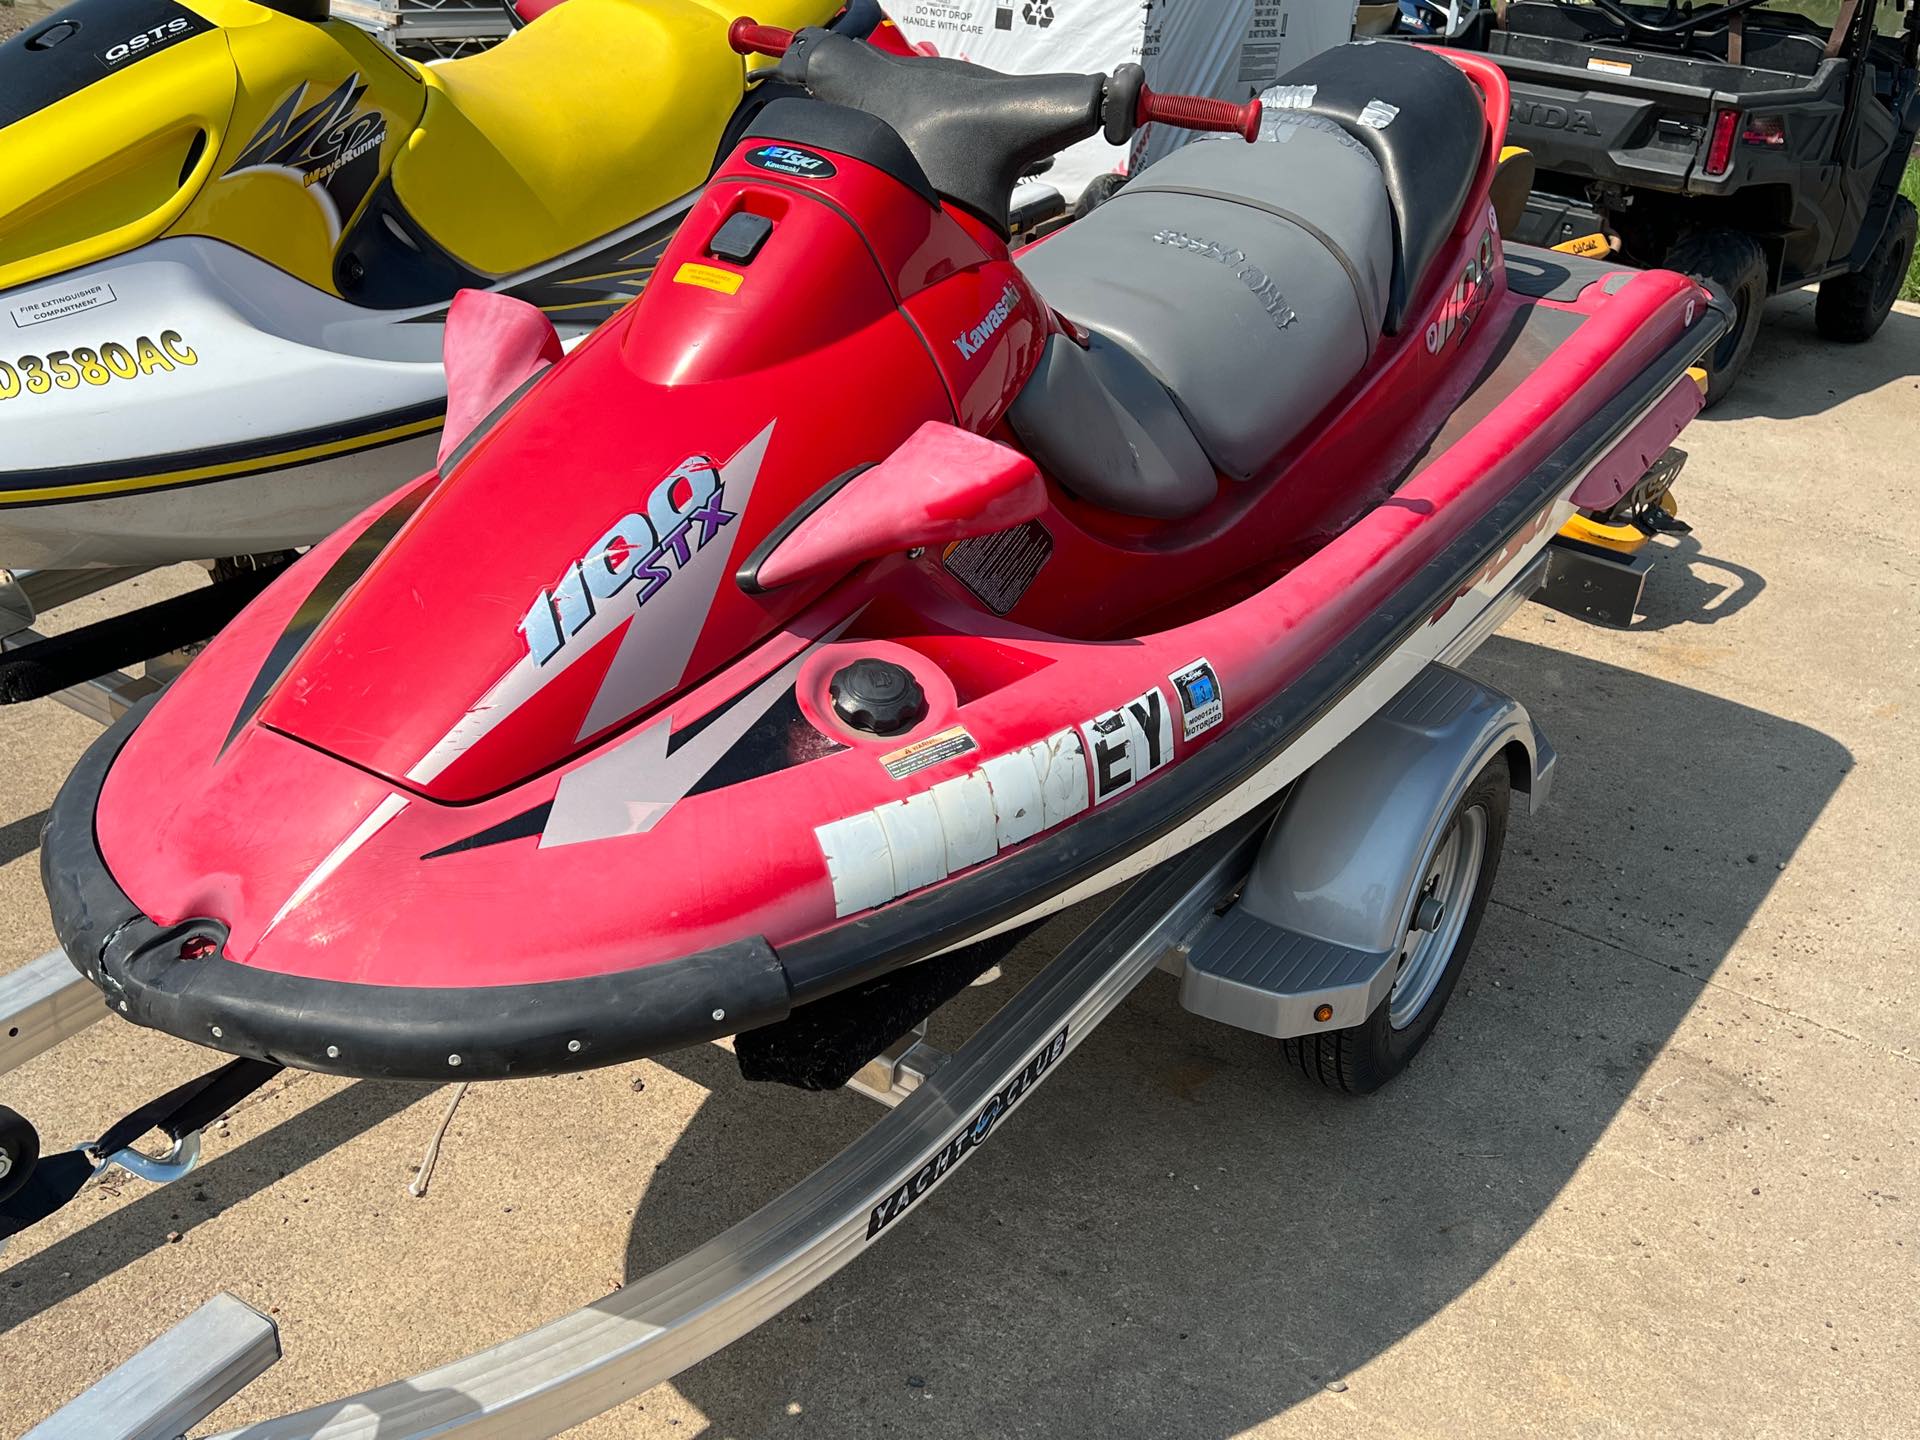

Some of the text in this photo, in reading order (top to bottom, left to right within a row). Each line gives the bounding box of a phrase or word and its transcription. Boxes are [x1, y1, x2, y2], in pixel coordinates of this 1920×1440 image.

[903, 16, 984, 35] HANDLE WITH CARE
[916, 5, 928, 14] DO
[930, 8, 946, 17] NOT
[948, 10, 973, 20] DROP
[105, 17, 188, 60] QSTS
[303, 129, 388, 187] WaveRunner
[764, 160, 800, 173] Kawasaki
[20, 286, 102, 314] FIRE EXTINGUISHER
[33, 297, 98, 320] COMPARTMENT
[954, 283, 1021, 361] Kawasaki
[636, 481, 738, 607] STX
[1185, 712, 1222, 737] MOTORIZED
[876, 1032, 1065, 1229] YACHT CLUB
